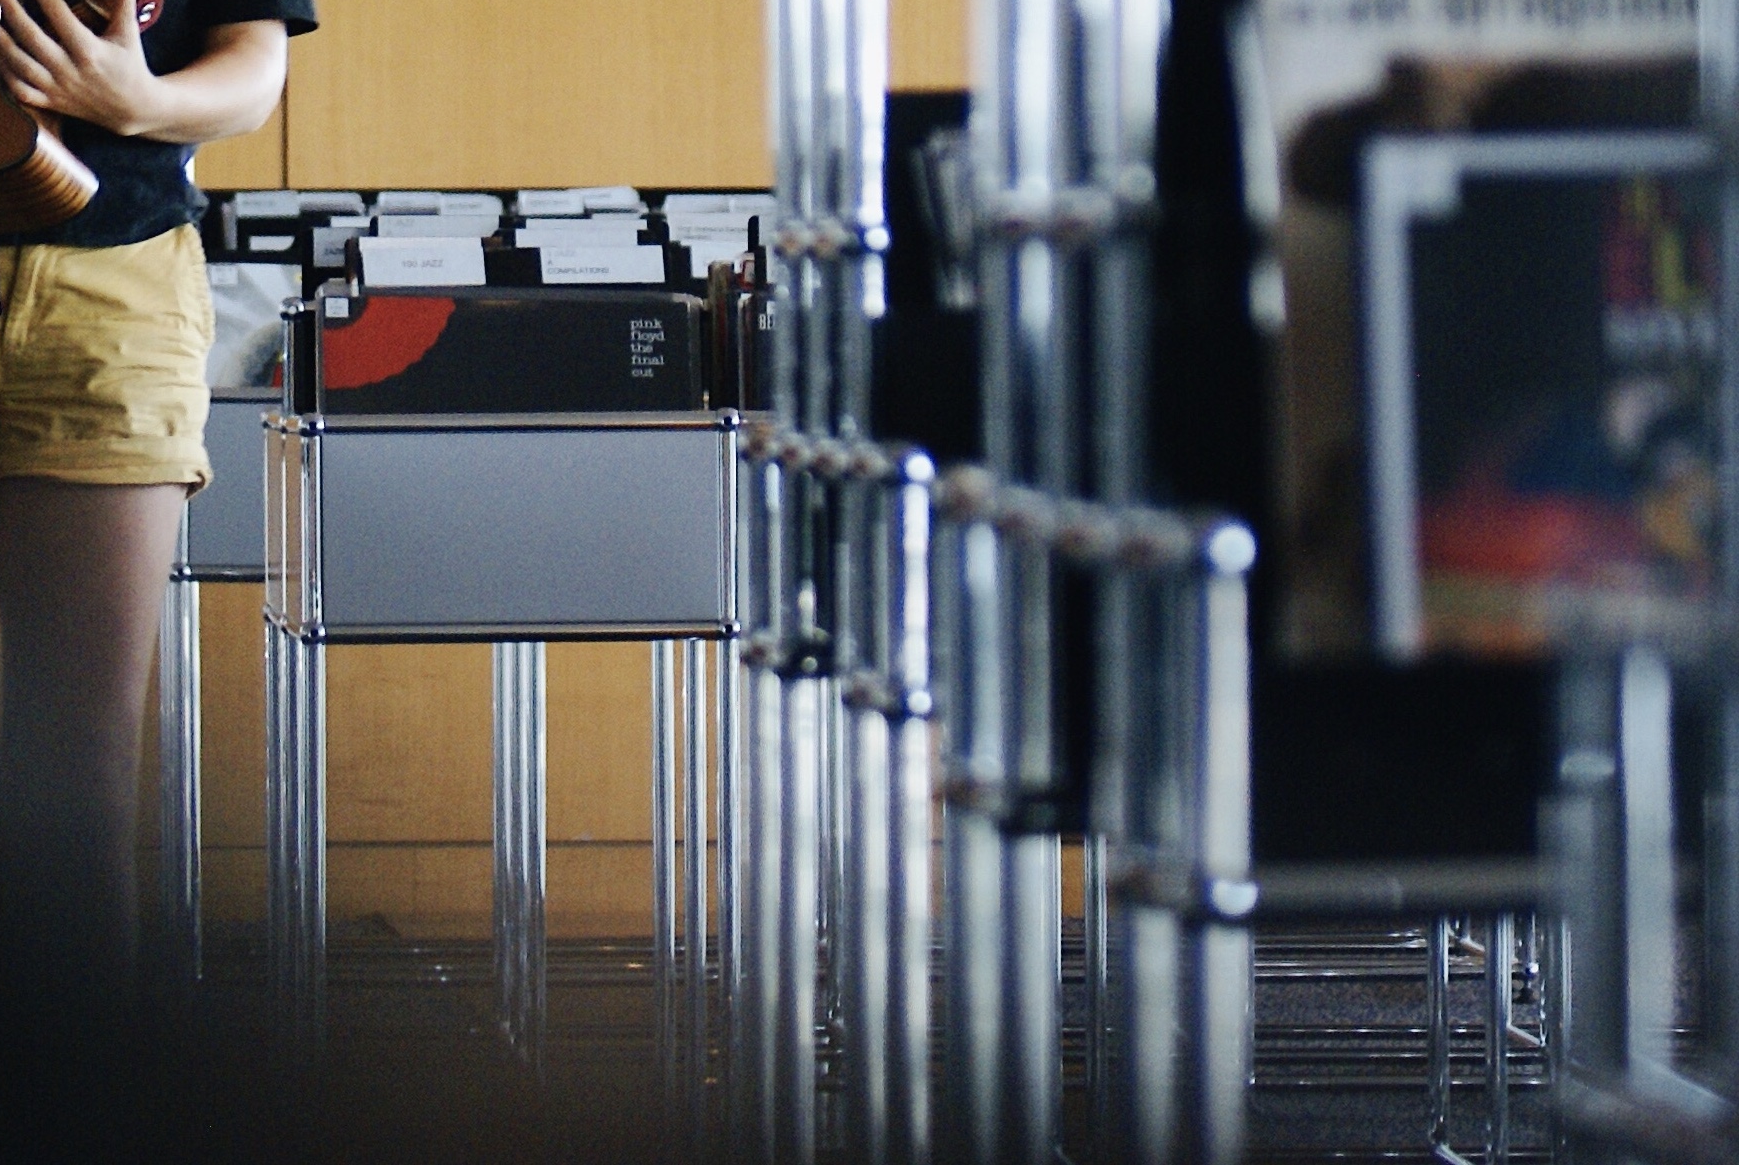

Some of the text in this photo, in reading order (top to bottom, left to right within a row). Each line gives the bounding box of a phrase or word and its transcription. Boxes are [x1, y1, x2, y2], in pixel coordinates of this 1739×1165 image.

[421, 259, 444, 269] JAZZ
[630, 318, 662, 331] pink
[630, 330, 666, 343] floyd
[630, 342, 654, 353] the
[631, 354, 665, 365] final
[631, 368, 655, 378] cut
